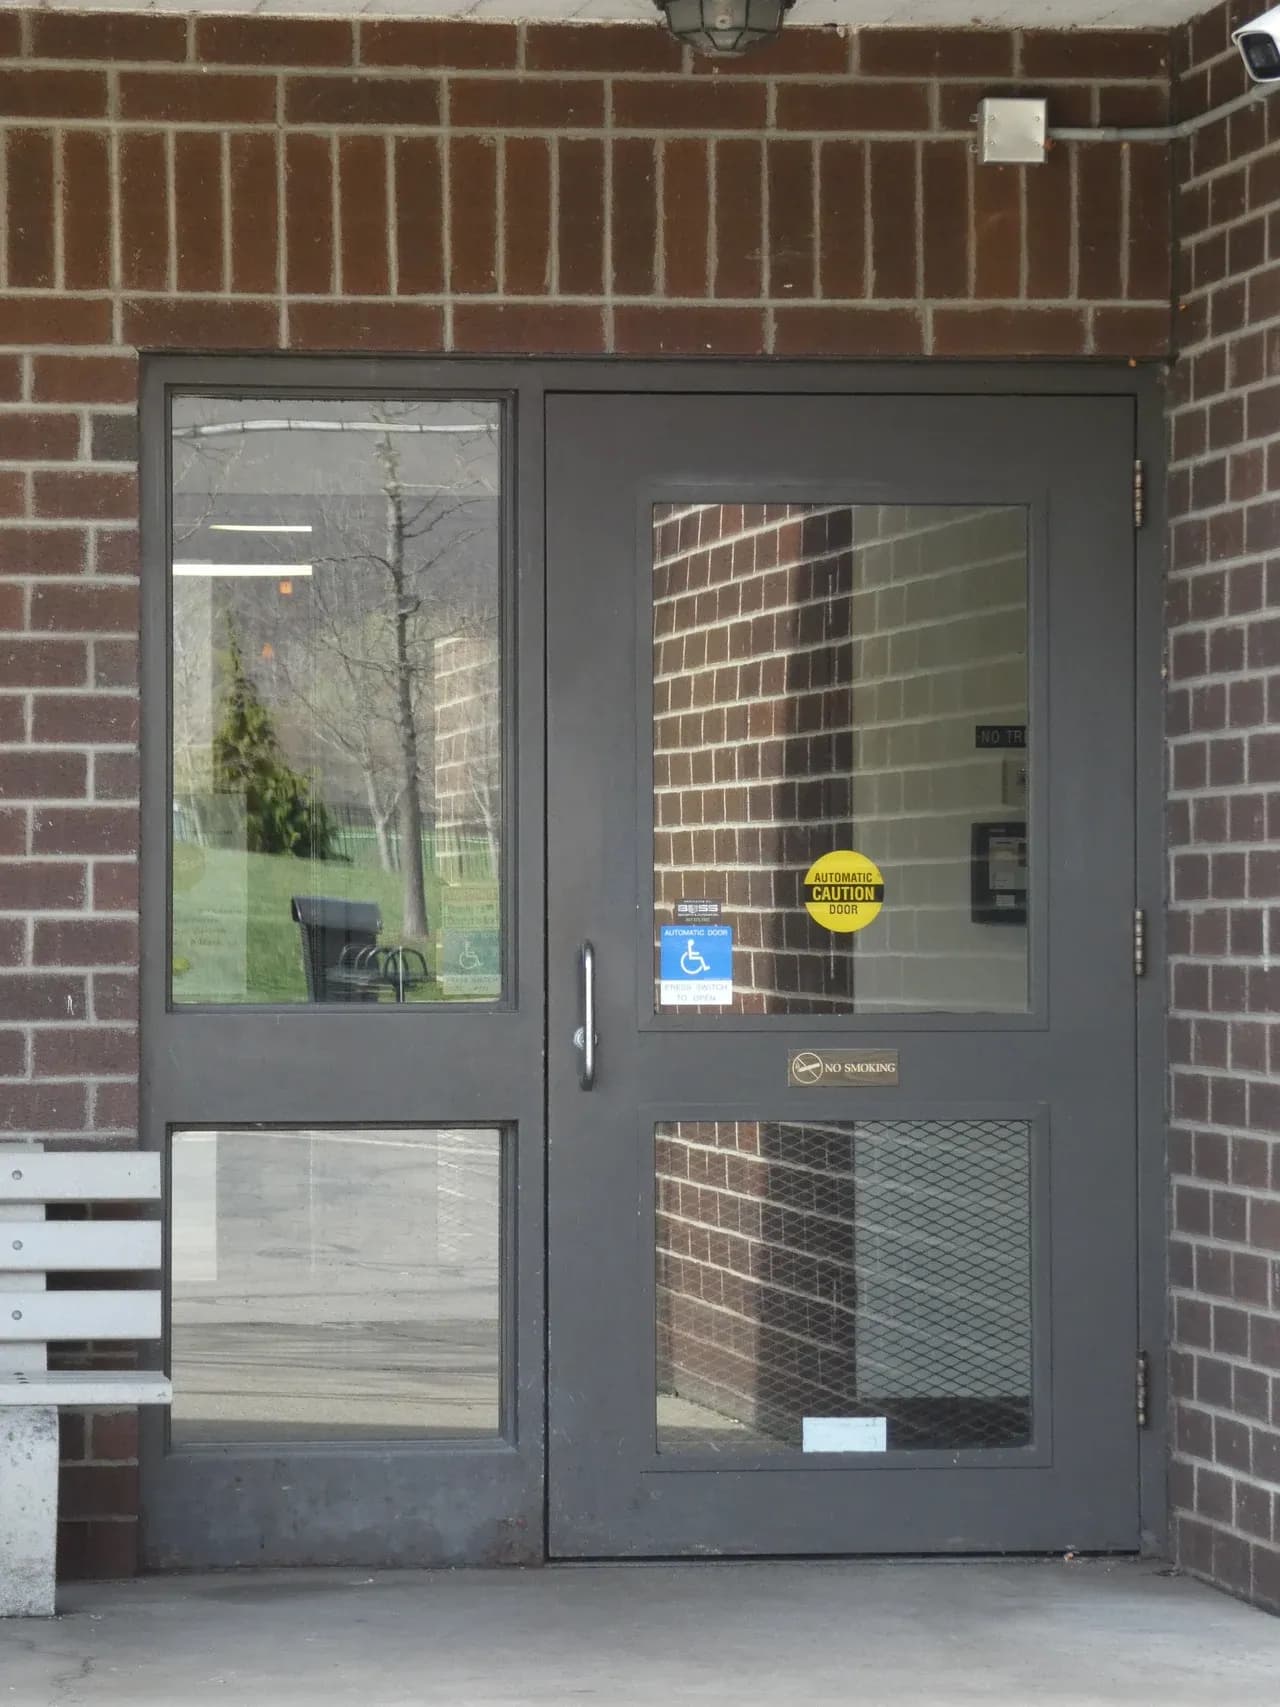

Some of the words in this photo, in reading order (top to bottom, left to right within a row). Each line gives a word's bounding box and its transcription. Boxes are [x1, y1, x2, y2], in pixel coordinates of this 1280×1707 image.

[981, 729, 1000, 745] NO
[814, 872, 873, 883] AUTOMATIC
[812, 886, 875, 901] CAUTION
[829, 904, 858, 915] DOOR
[696, 983, 728, 991] SWITCH
[677, 994, 688, 1002] TO
[825, 1063, 842, 1073] NO
[844, 1063, 896, 1073] SMOKING
